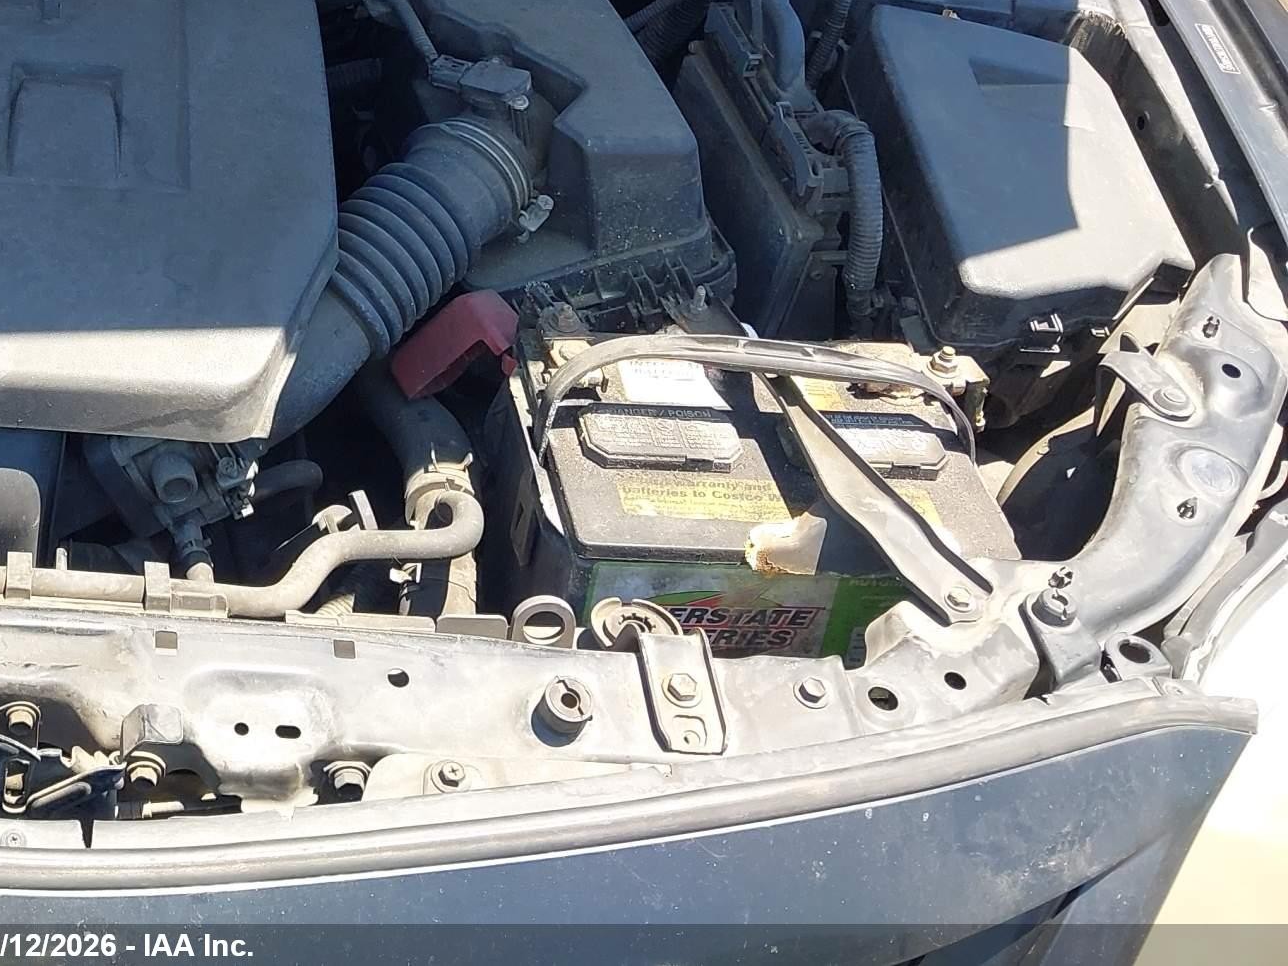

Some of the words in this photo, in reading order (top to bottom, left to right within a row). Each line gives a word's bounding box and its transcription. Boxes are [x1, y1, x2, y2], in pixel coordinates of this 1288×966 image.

[668, 409, 712, 419] POISON
[622, 485, 688, 498] batteries
[692, 489, 707, 498] to
[711, 489, 763, 502] Costco
[668, 607, 815, 627] ERSTATE
